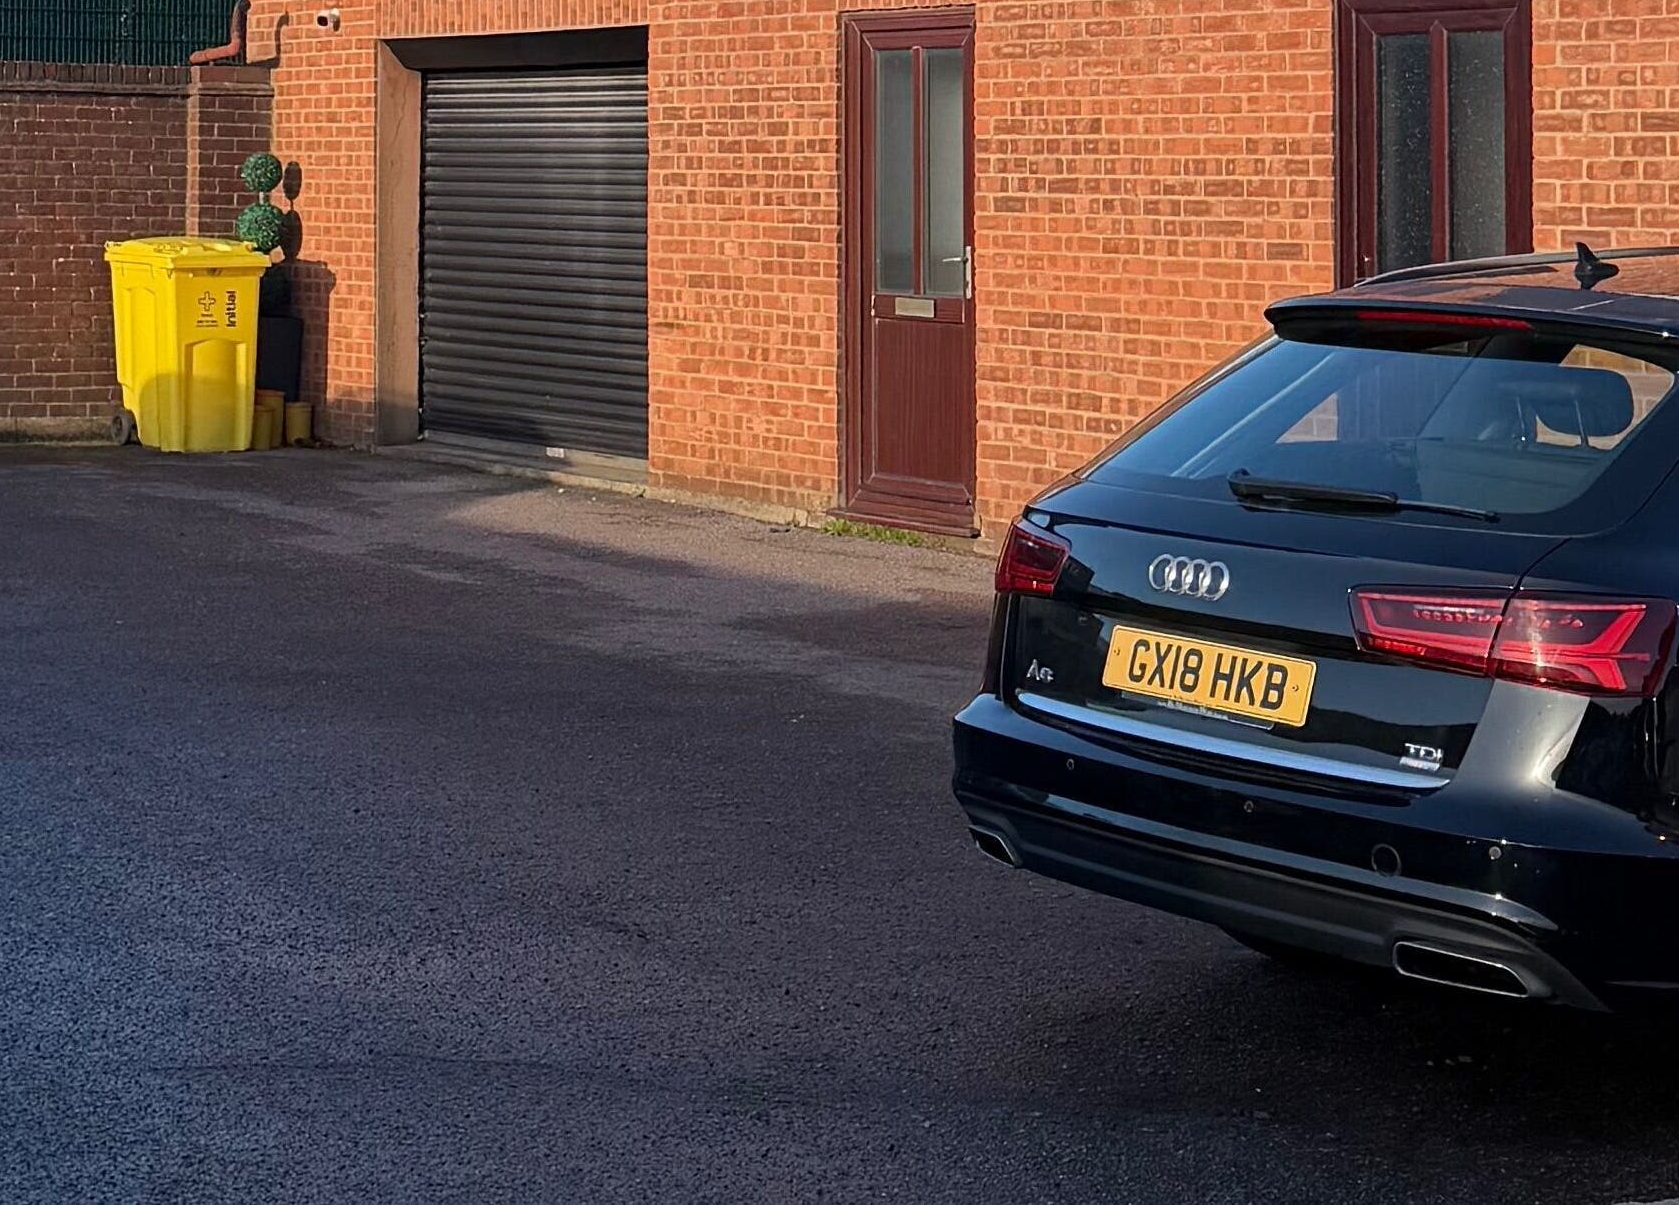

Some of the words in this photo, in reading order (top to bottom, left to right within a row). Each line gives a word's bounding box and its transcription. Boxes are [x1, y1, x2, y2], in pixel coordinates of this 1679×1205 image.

[224, 290, 236, 327] Initial
[1026, 658, 1054, 683] A6
[1128, 638, 1203, 693] GX18
[1209, 652, 1288, 711] HKB
[1404, 743, 1443, 763] TDI
